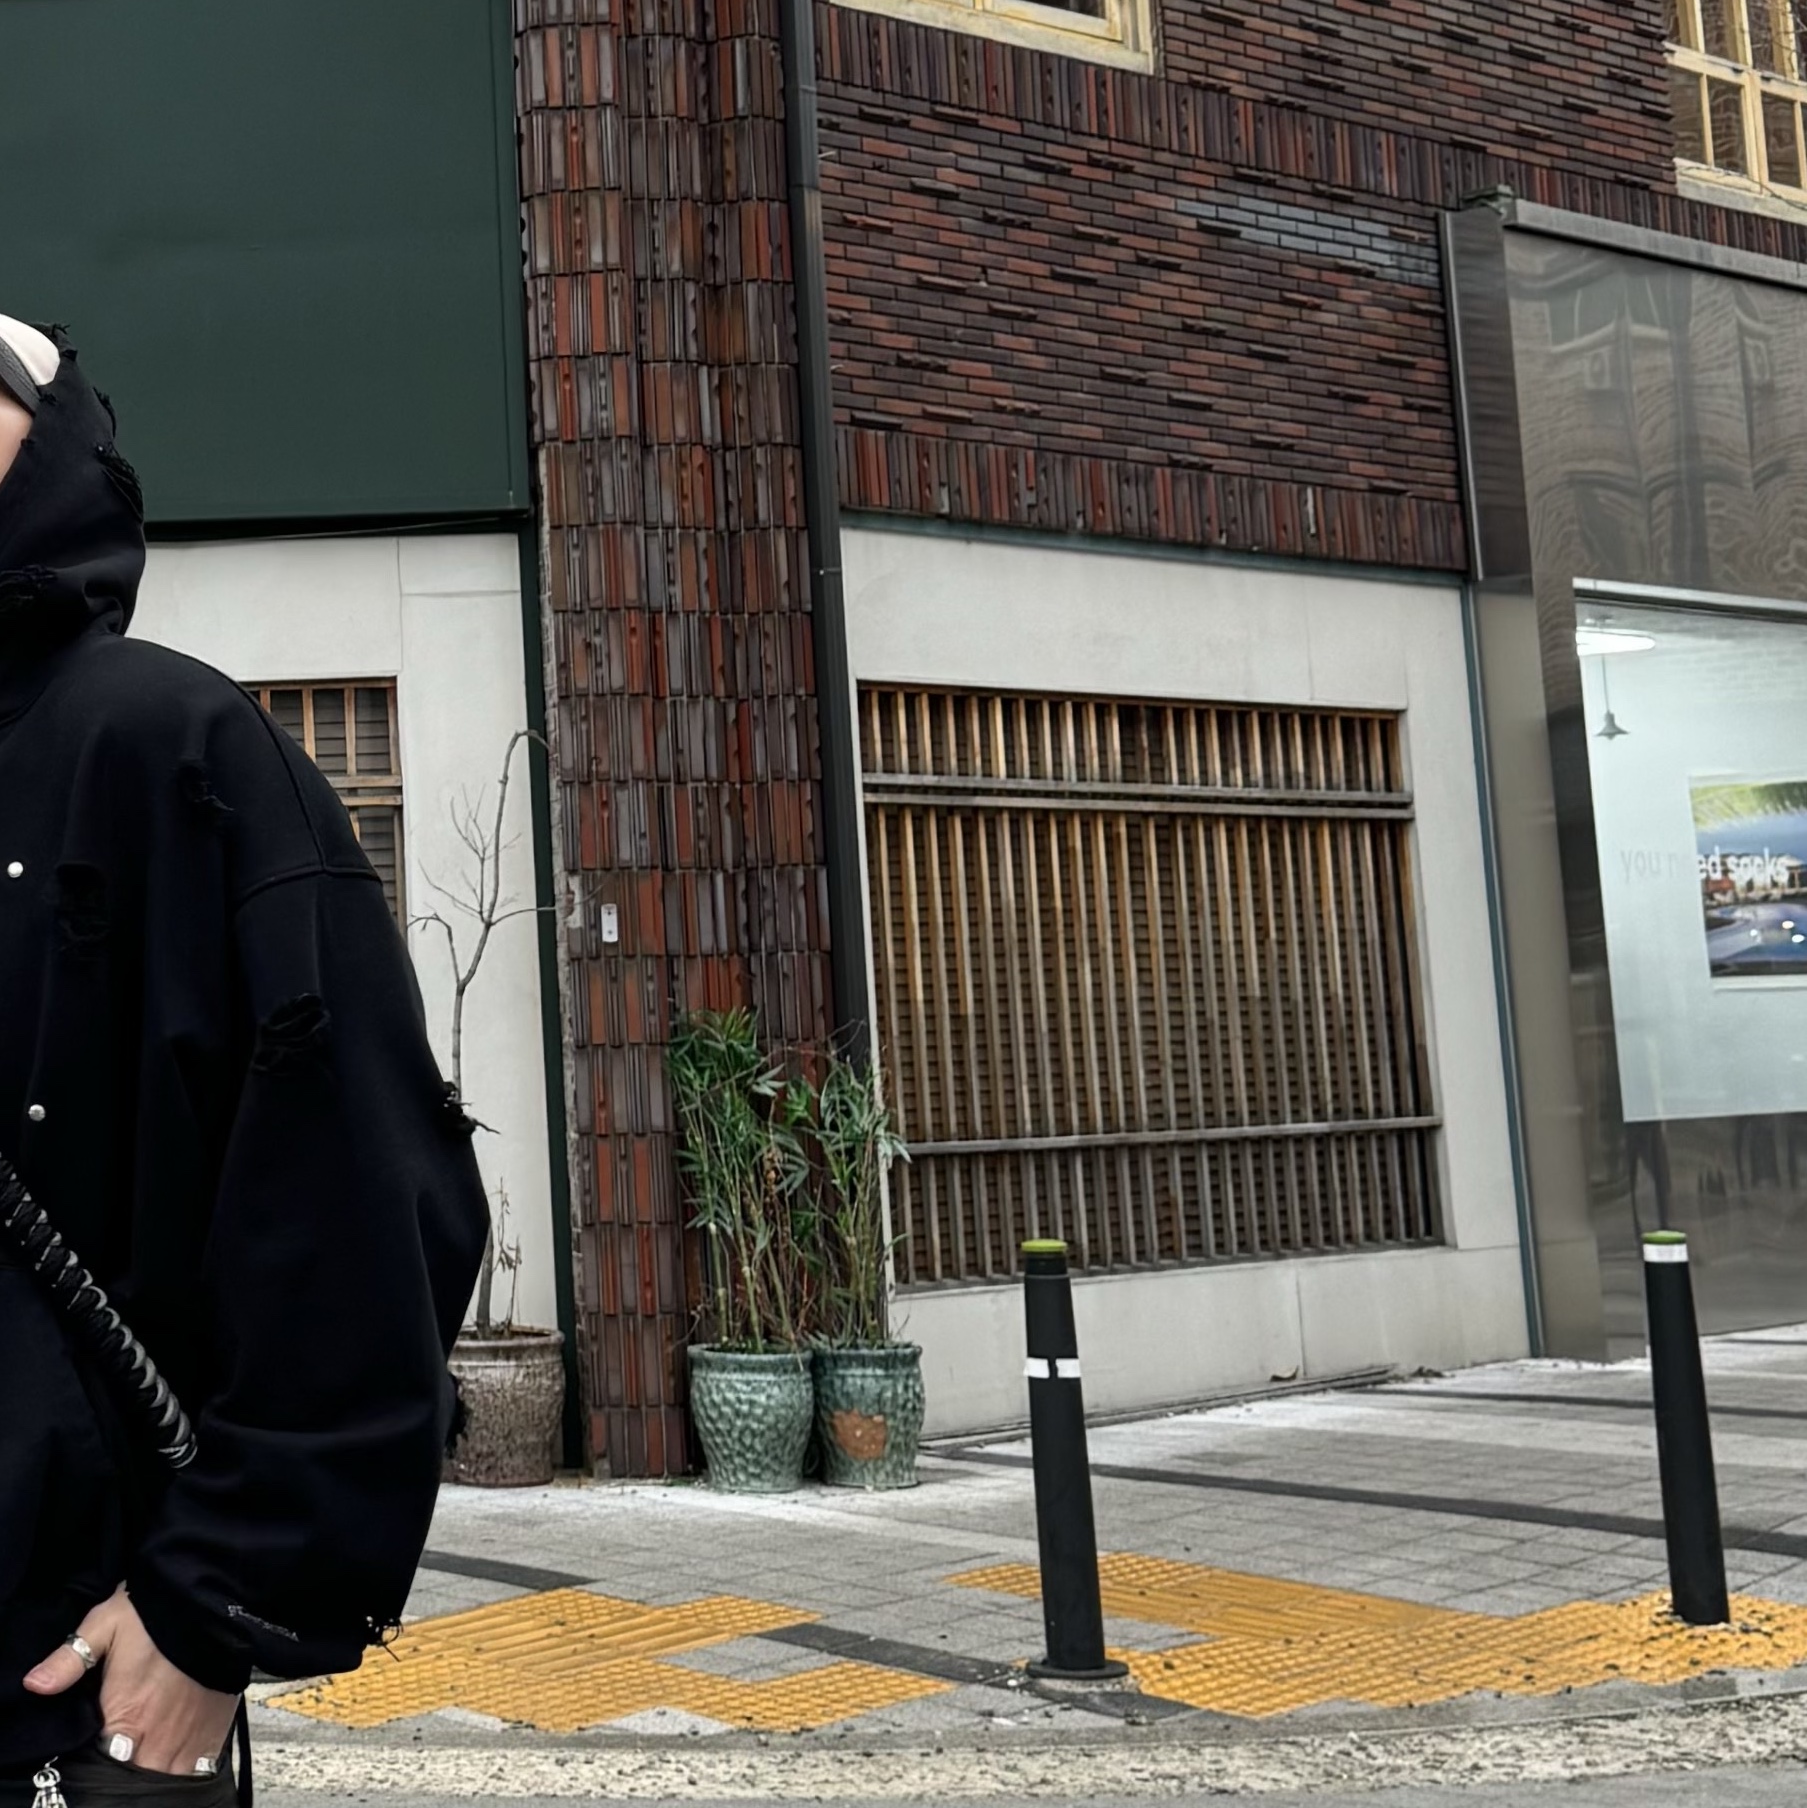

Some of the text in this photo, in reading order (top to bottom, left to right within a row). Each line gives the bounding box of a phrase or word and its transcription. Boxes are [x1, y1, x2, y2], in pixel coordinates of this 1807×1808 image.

[1620, 845, 1789, 884] you ned socks
